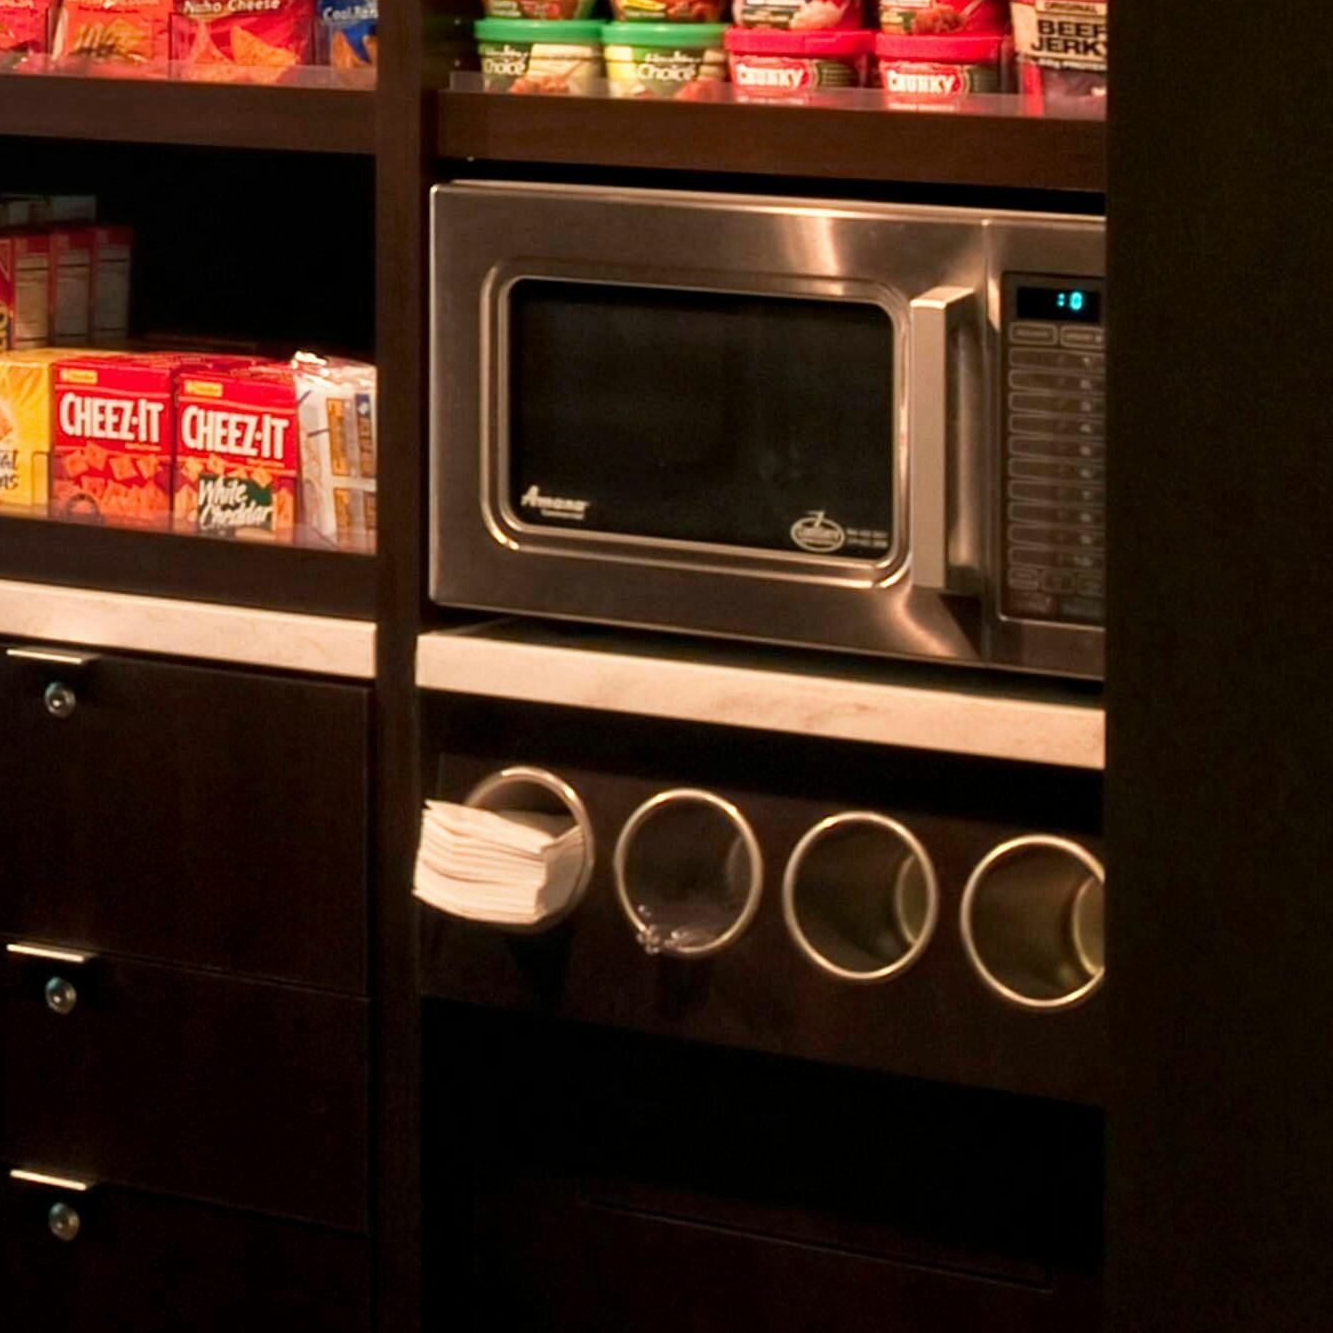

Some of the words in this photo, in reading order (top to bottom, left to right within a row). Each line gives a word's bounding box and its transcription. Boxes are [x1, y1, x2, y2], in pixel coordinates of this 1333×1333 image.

[637, 63, 697, 82] Choice
[736, 63, 805, 88] CHUNKY
[886, 69, 955, 95] CHUNKY
[198, 477, 248, 507] White
[199, 502, 273, 532] Cheddar
